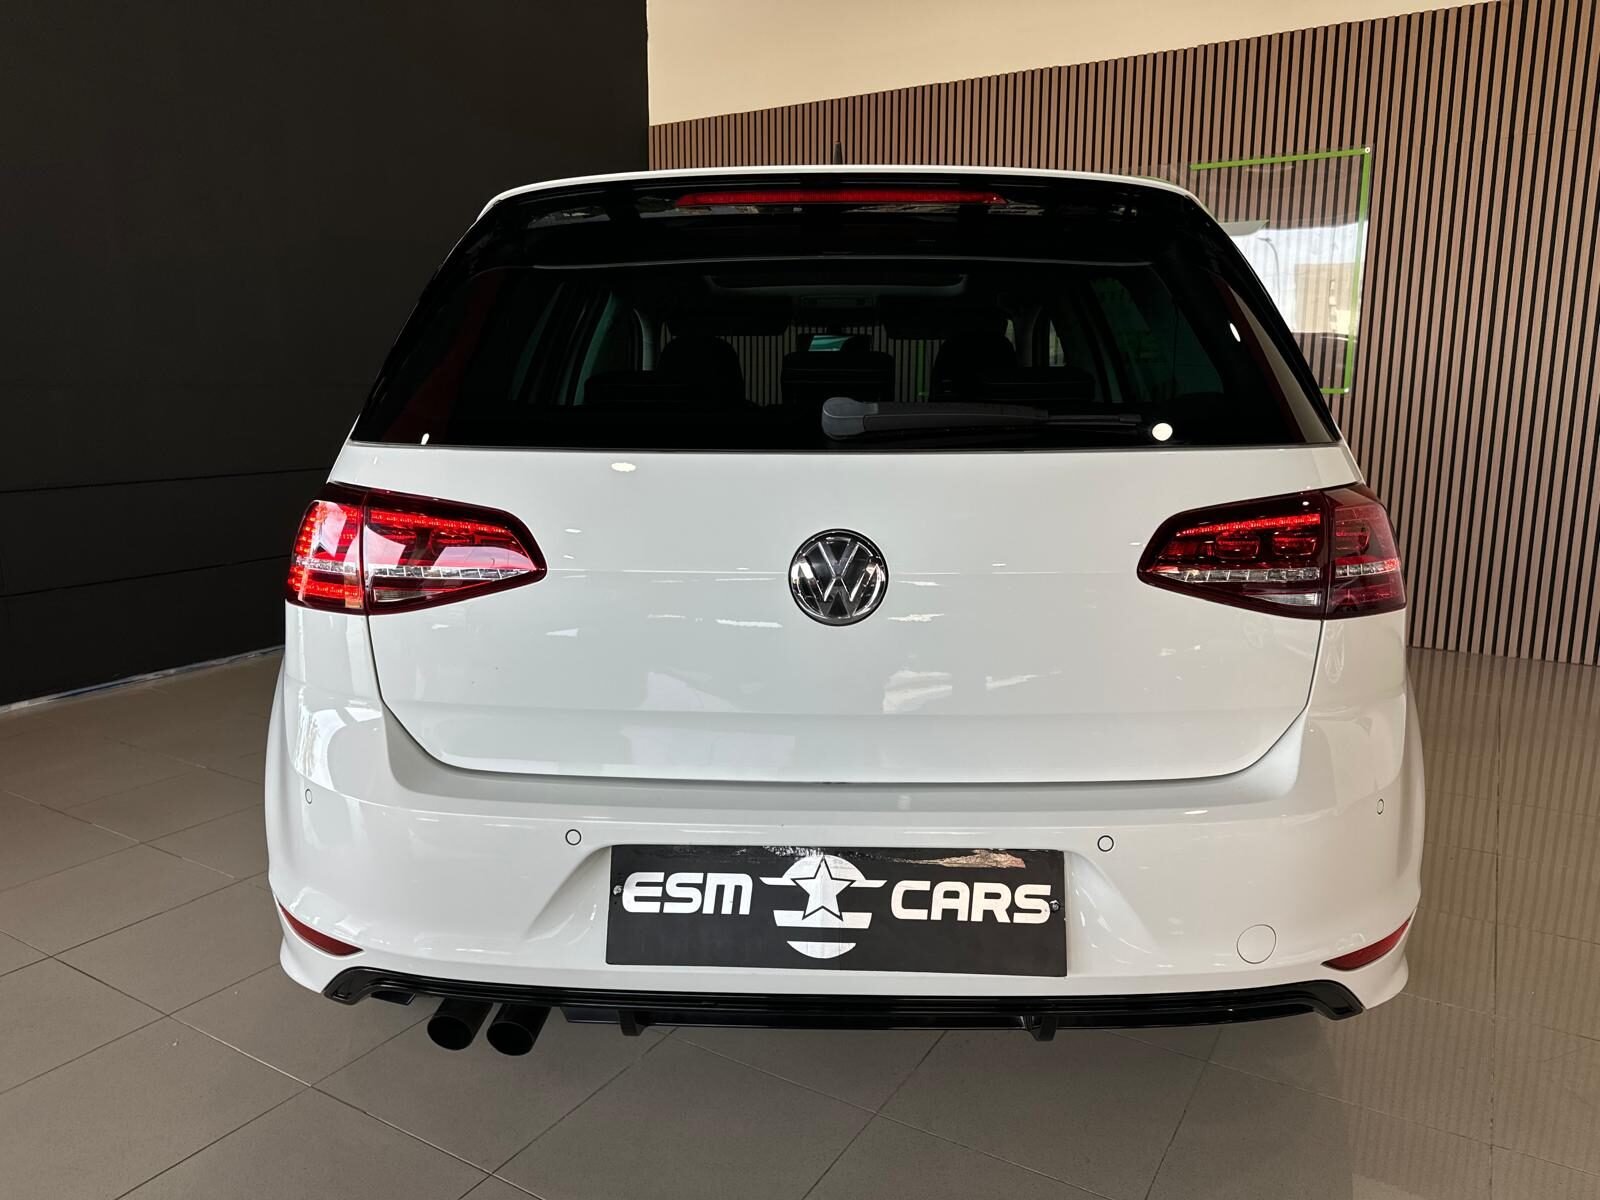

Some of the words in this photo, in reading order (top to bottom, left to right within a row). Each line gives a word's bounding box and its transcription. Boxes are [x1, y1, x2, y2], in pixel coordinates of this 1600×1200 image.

[790, 532, 887, 624] VW
[622, 871, 753, 916] ESM
[890, 880, 1052, 925] CARS
